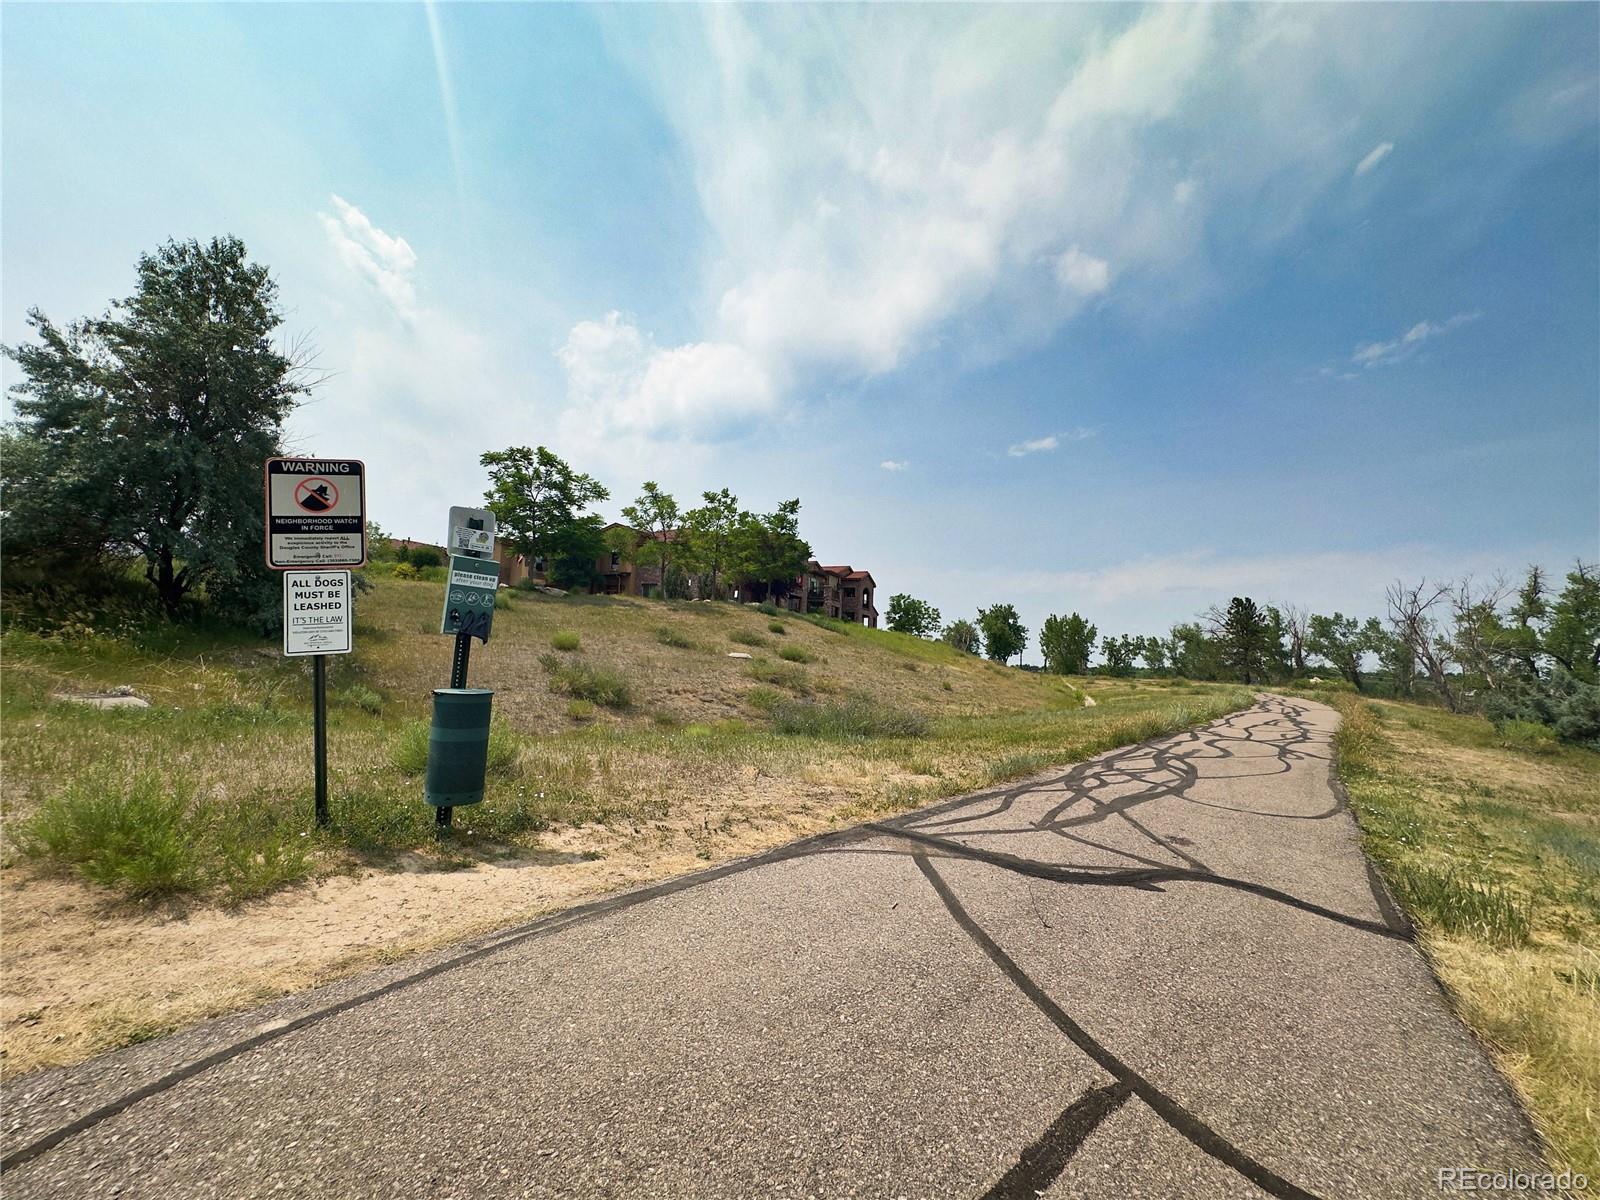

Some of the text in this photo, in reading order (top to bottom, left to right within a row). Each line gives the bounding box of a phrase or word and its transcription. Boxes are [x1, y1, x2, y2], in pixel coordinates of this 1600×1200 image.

[282, 462, 350, 472] WARNING
[315, 579, 344, 587] DOGS
[295, 591, 324, 599] MUST
[294, 602, 341, 611] LEASHED
